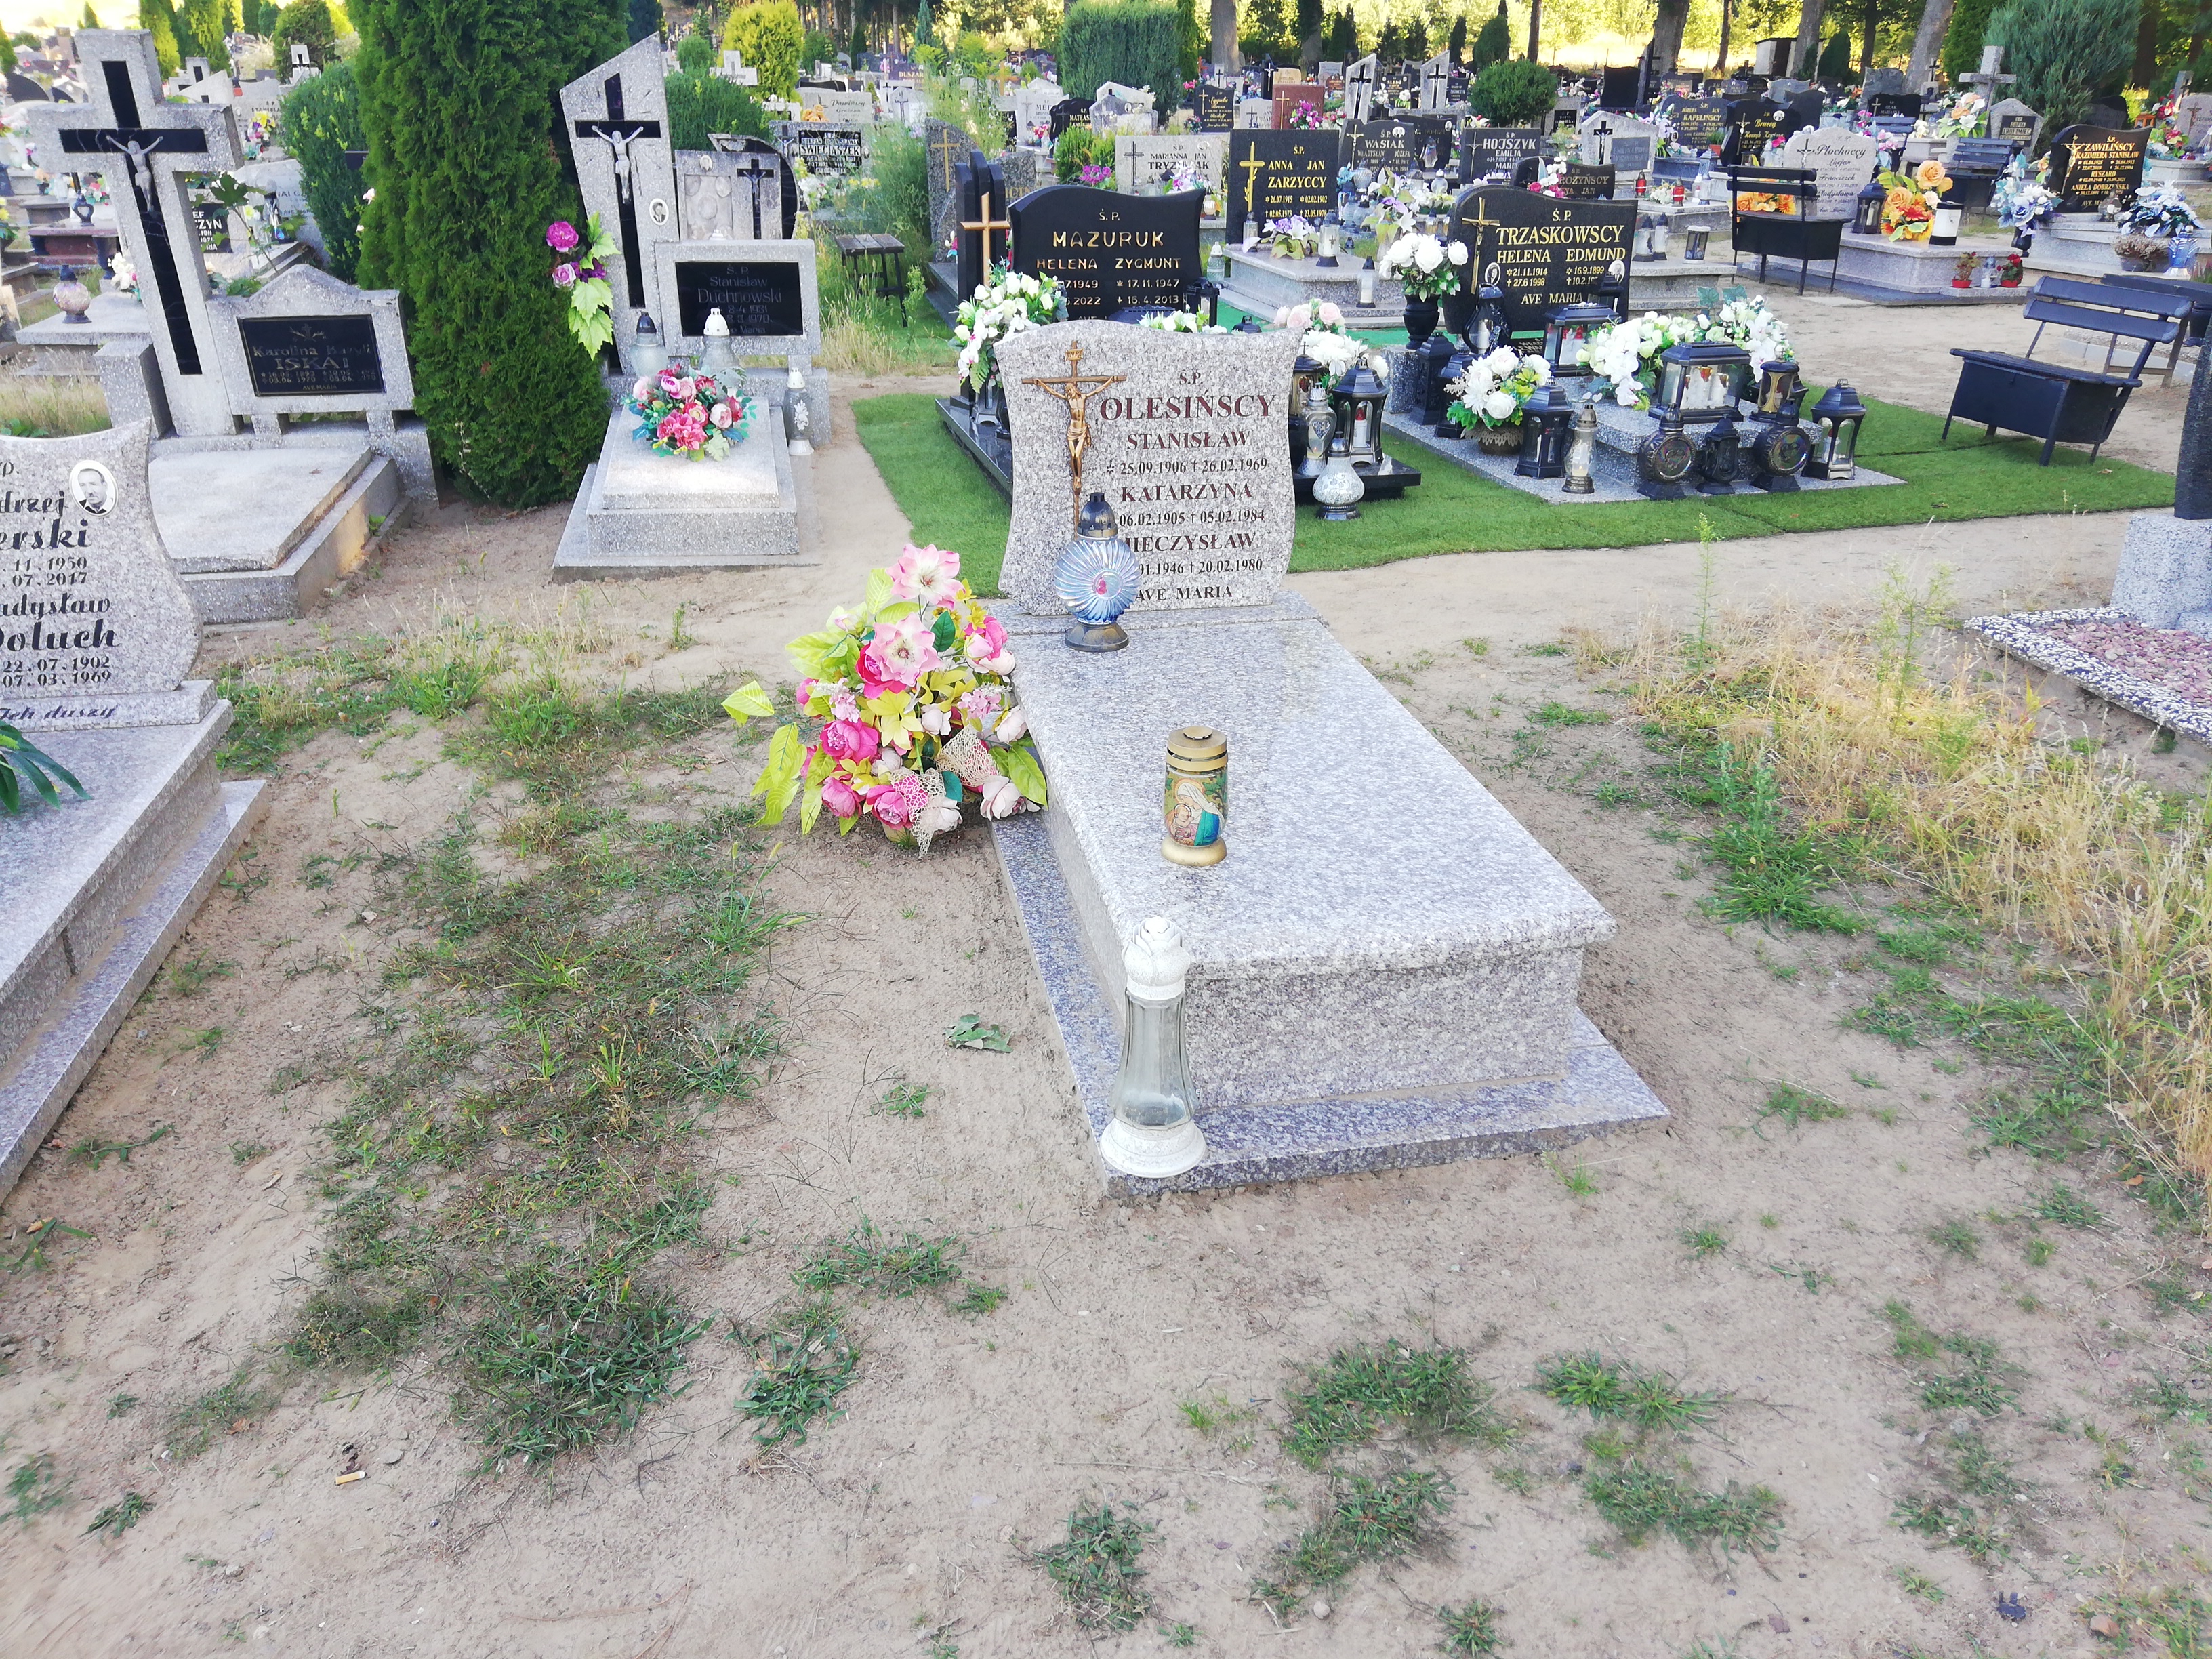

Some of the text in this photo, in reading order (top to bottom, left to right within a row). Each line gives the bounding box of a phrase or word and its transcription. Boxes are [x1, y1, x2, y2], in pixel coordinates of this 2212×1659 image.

[1365, 140, 1405, 148] WASIAK
[1483, 138, 1537, 150] HOJSZYK
[2083, 140, 2135, 152] ZAWILIŃSCY
[1268, 160, 1325, 171] ANNA JAN
[1267, 176, 1327, 188] ZARZYCCY
[195, 219, 222, 230] ZYN
[1052, 231, 1164, 247] MAZURUK
[1495, 225, 1625, 246] TRZASKOWSCY
[1496, 247, 1626, 264] HELENA EDMUND
[1036, 258, 1182, 270] HELENA ZYGMUNT
[1513, 268, 1548, 276] 21.11.1914
[698, 287, 782, 303] Duchnowski
[1520, 292, 1583, 305] AVE MARIA
[1100, 389, 1276, 421] OLESIŃSCY
[1126, 430, 1250, 450] STANISŁAW
[1120, 458, 1268, 475] 25.09.1906 26.02.1969
[1121, 483, 1253, 503] KATARZYNA
[1119, 509, 1265, 527] 06.02.1905 05.02.1984
[1199, 559, 1263, 574] 20.02.1980
[1135, 586, 1233, 601] AVE MARIA
[0, 618, 121, 652] oluch
[43, 704, 121, 720] duszy
